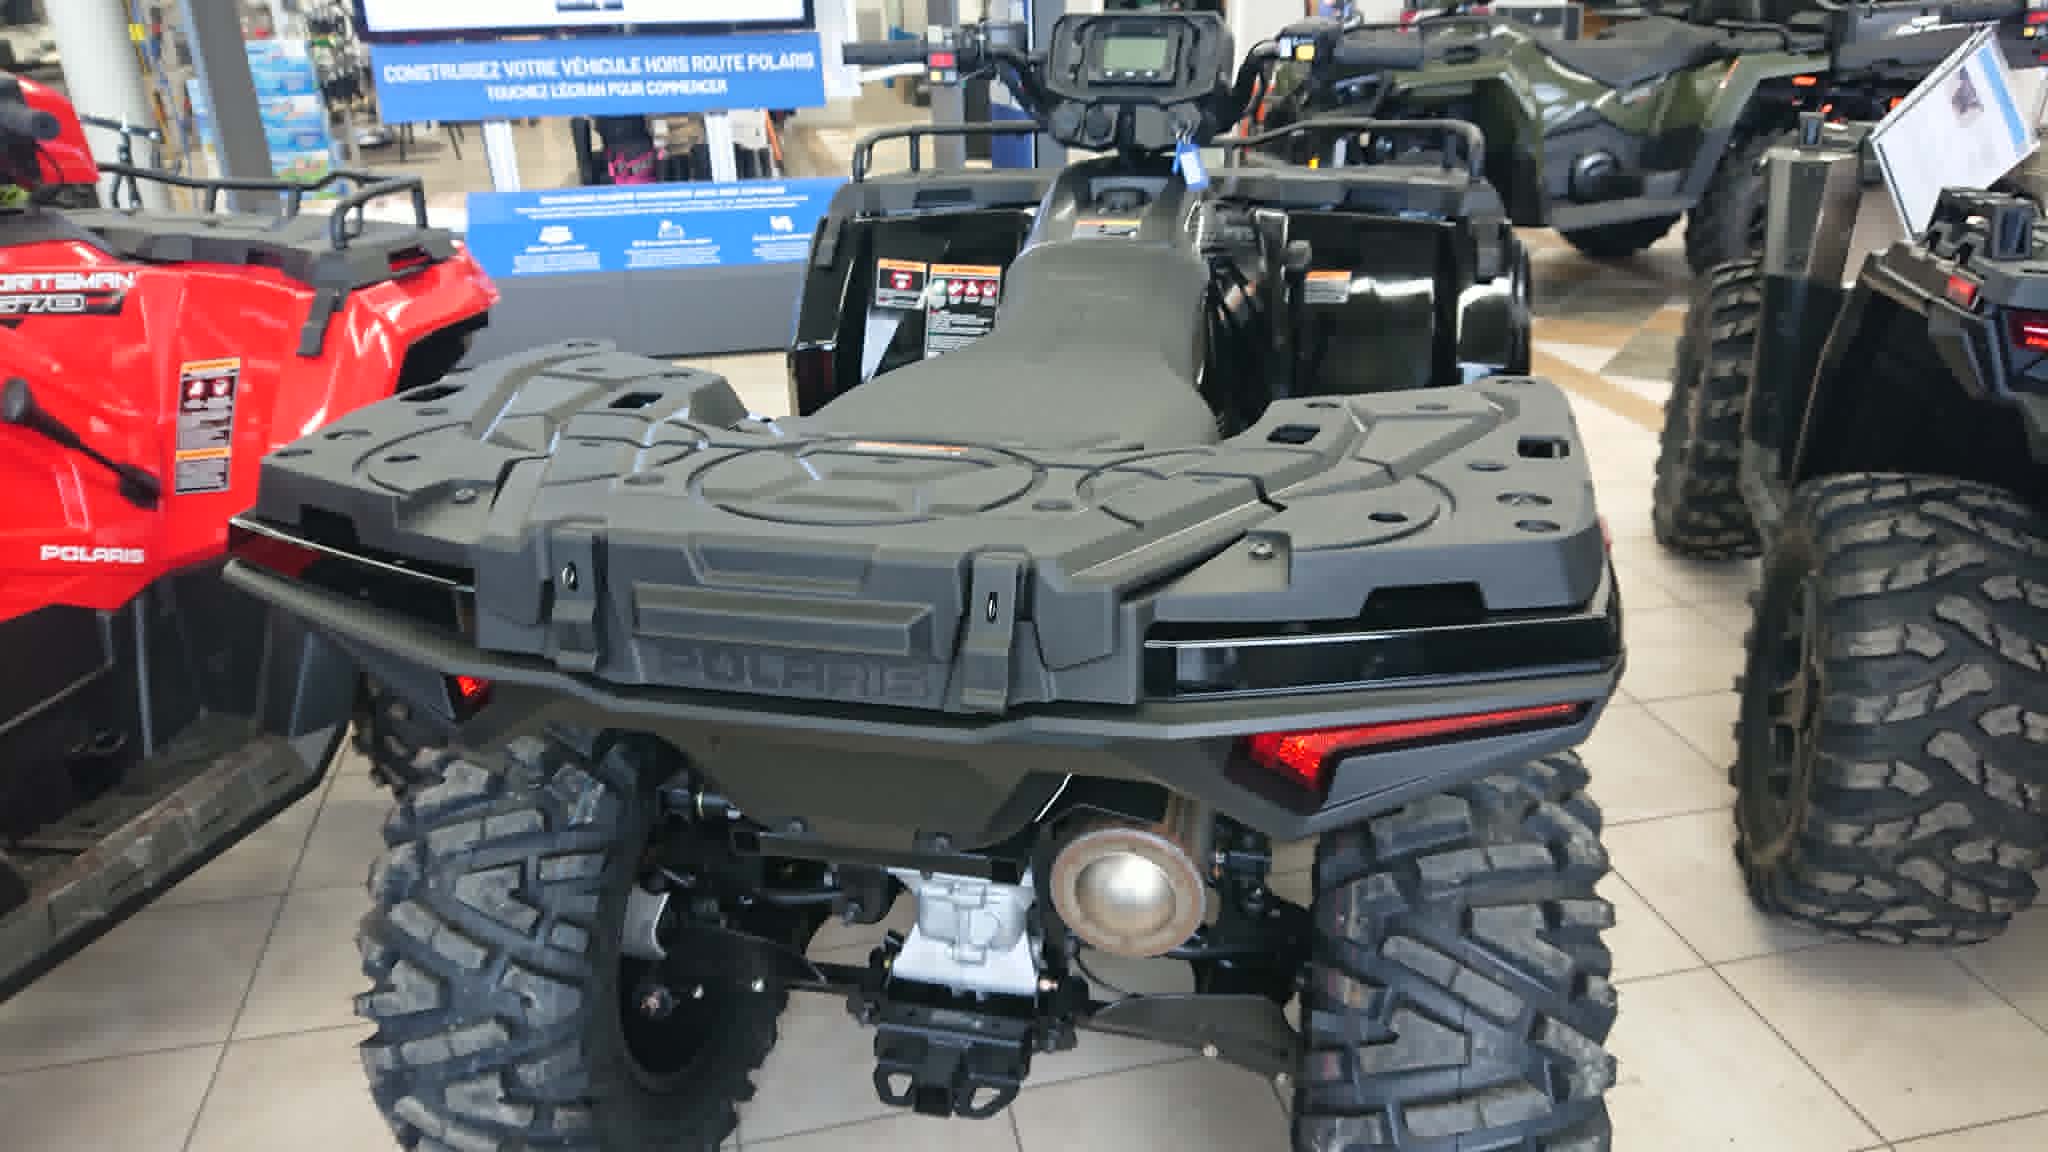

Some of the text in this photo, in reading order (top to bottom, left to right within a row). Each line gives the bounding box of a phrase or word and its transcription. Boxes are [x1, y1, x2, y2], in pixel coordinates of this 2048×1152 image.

[693, 53, 745, 72] ROUTE
[748, 51, 815, 72] POLARIS
[40, 544, 144, 564] POLARIS
[662, 648, 930, 700] POLARIS
